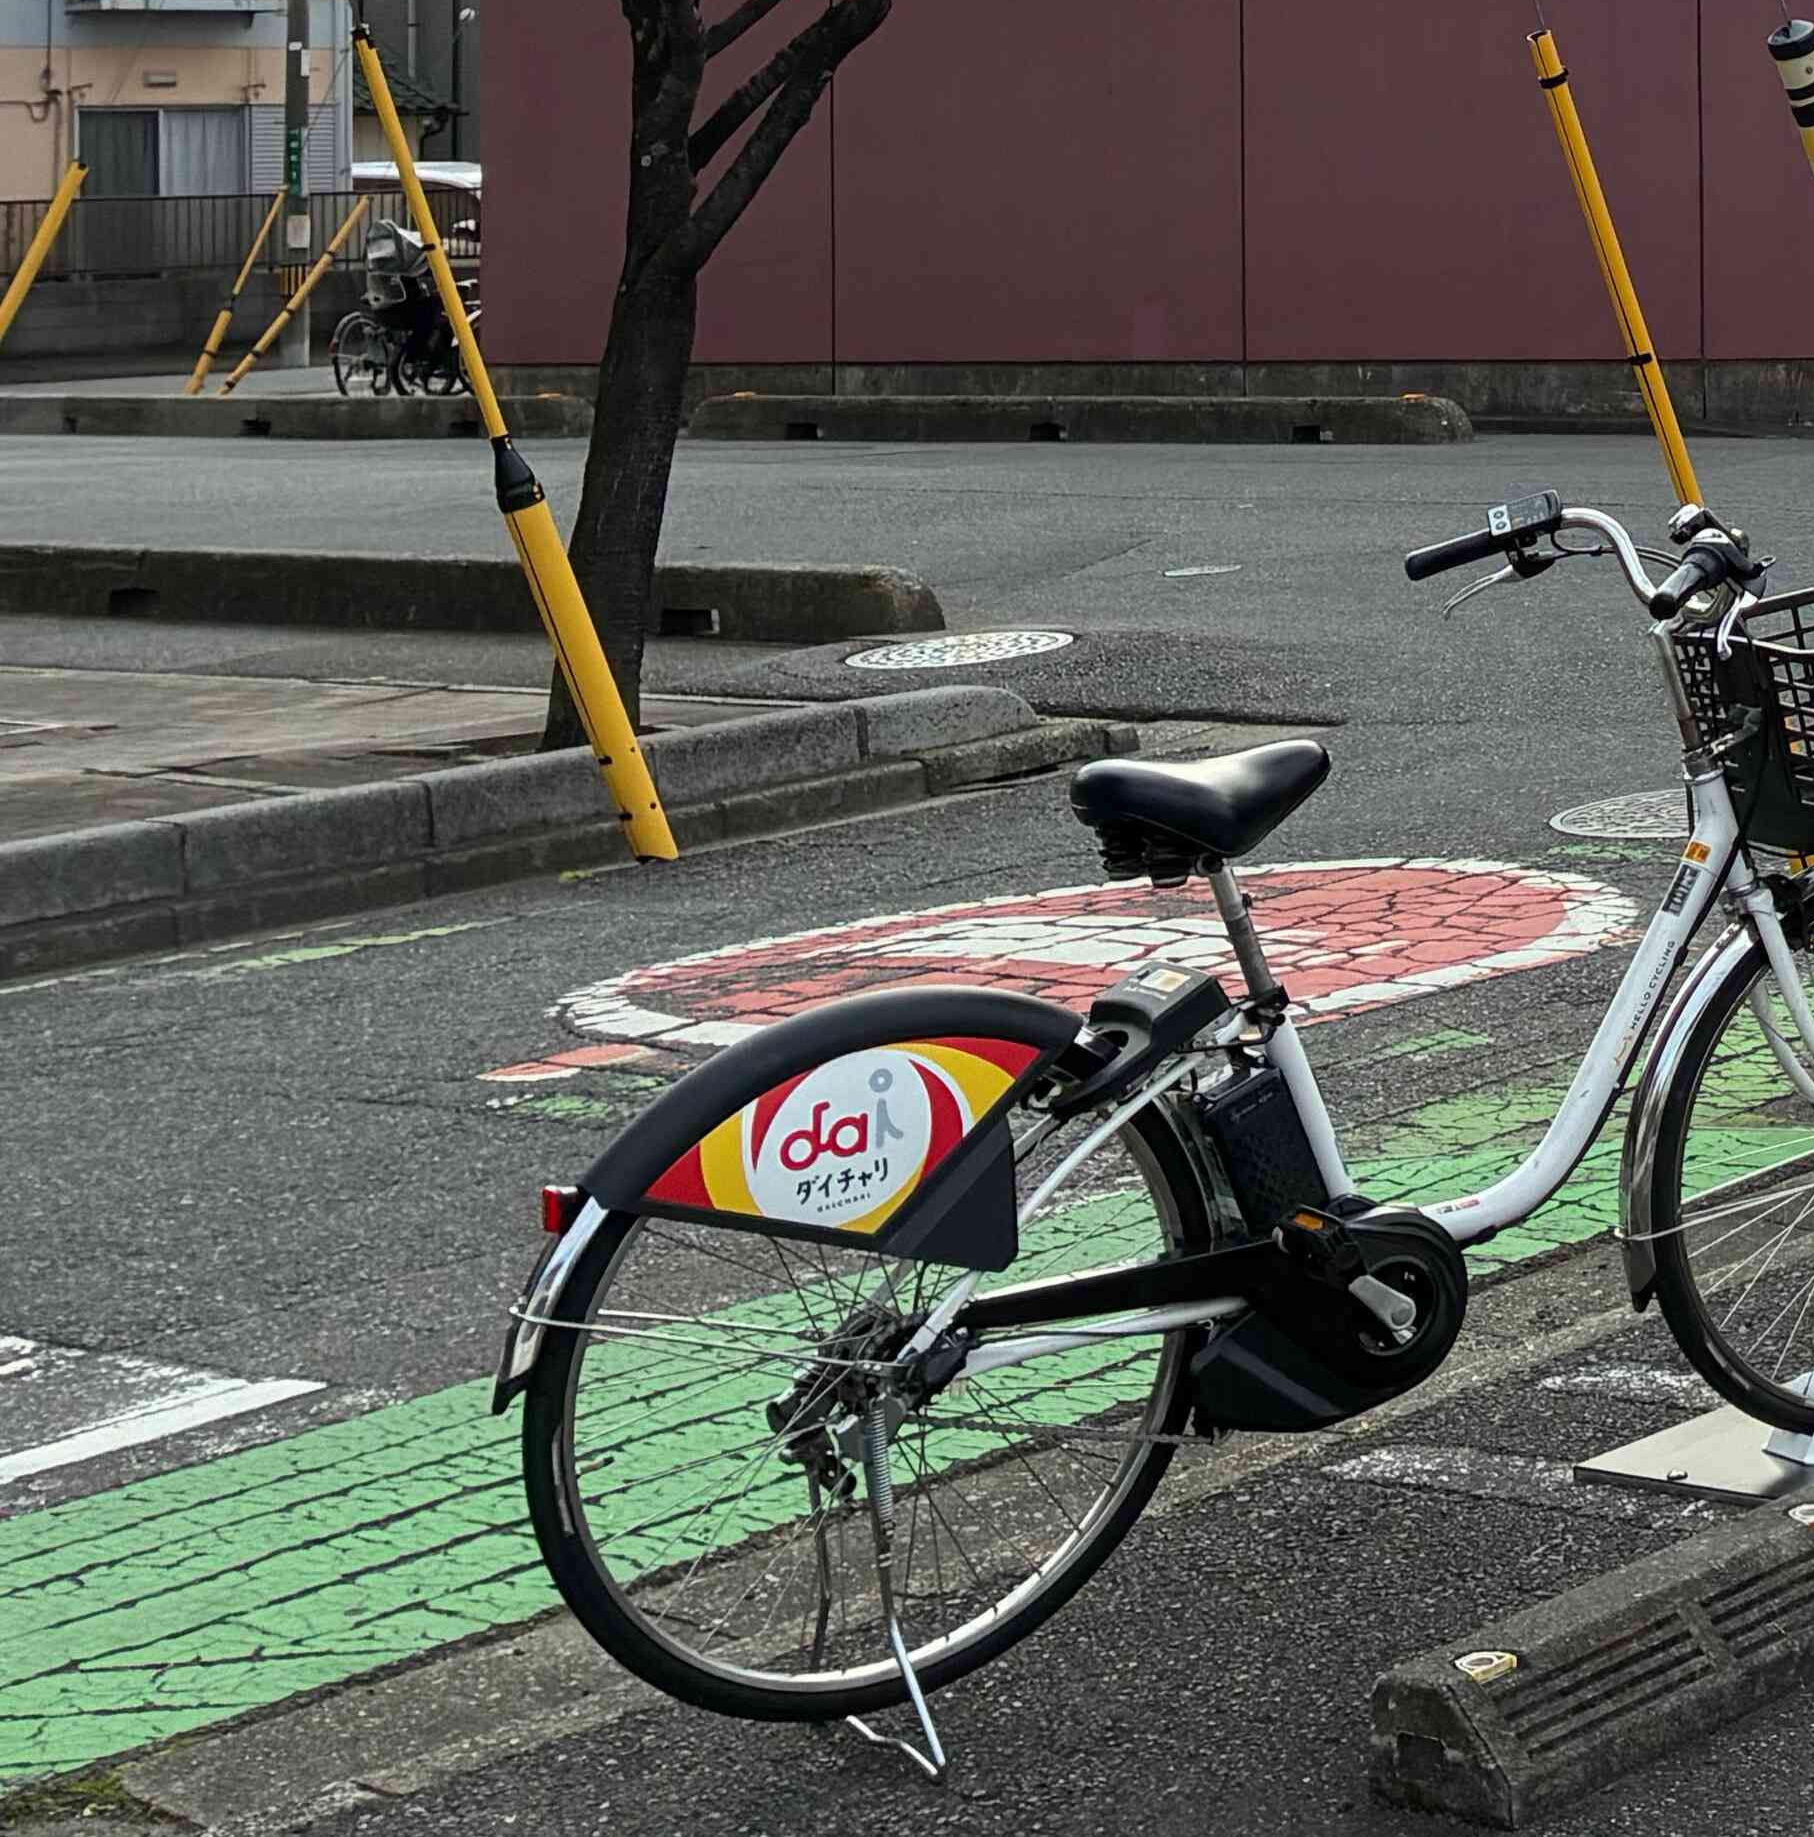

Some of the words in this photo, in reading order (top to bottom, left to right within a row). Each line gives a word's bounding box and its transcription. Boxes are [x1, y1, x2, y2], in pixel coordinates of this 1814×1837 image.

[1631, 993, 1652, 1030] HELLO
[1648, 939, 1676, 990] CYCLING
[779, 1067, 905, 1172] dai
[796, 1156, 889, 1206] ダイチャリ
